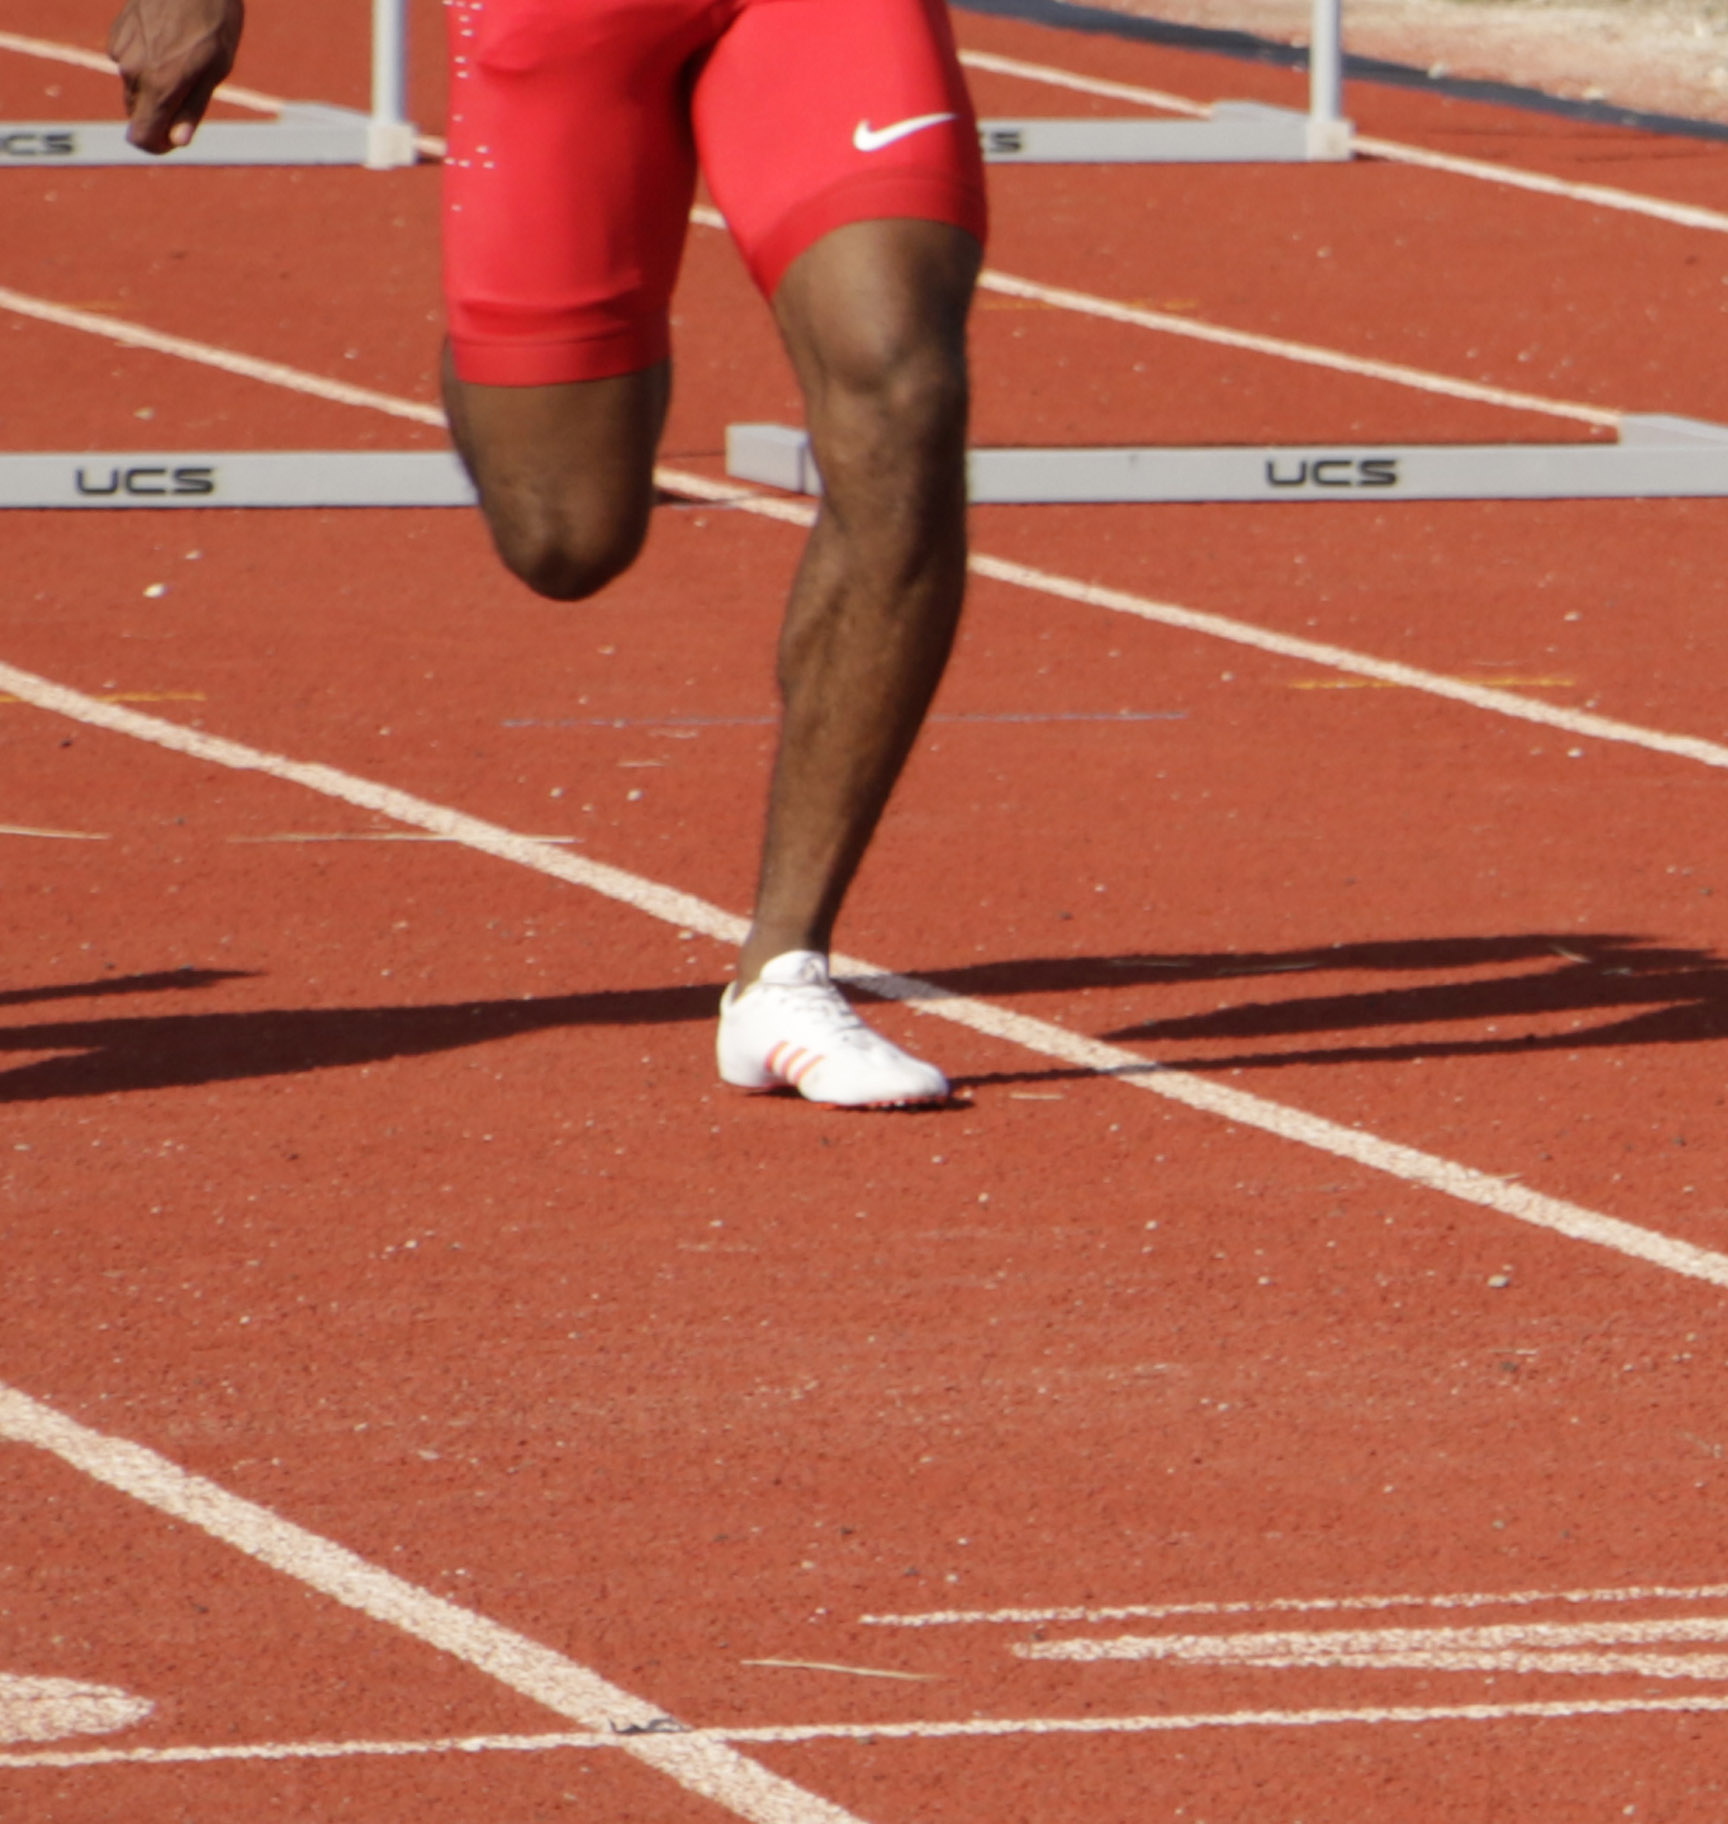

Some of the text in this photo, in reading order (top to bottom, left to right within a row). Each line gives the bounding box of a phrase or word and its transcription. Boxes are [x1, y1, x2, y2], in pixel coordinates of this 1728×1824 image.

[0, 132, 74, 156] CS
[75, 467, 214, 494] UCS
[1265, 459, 1398, 486] UCS
